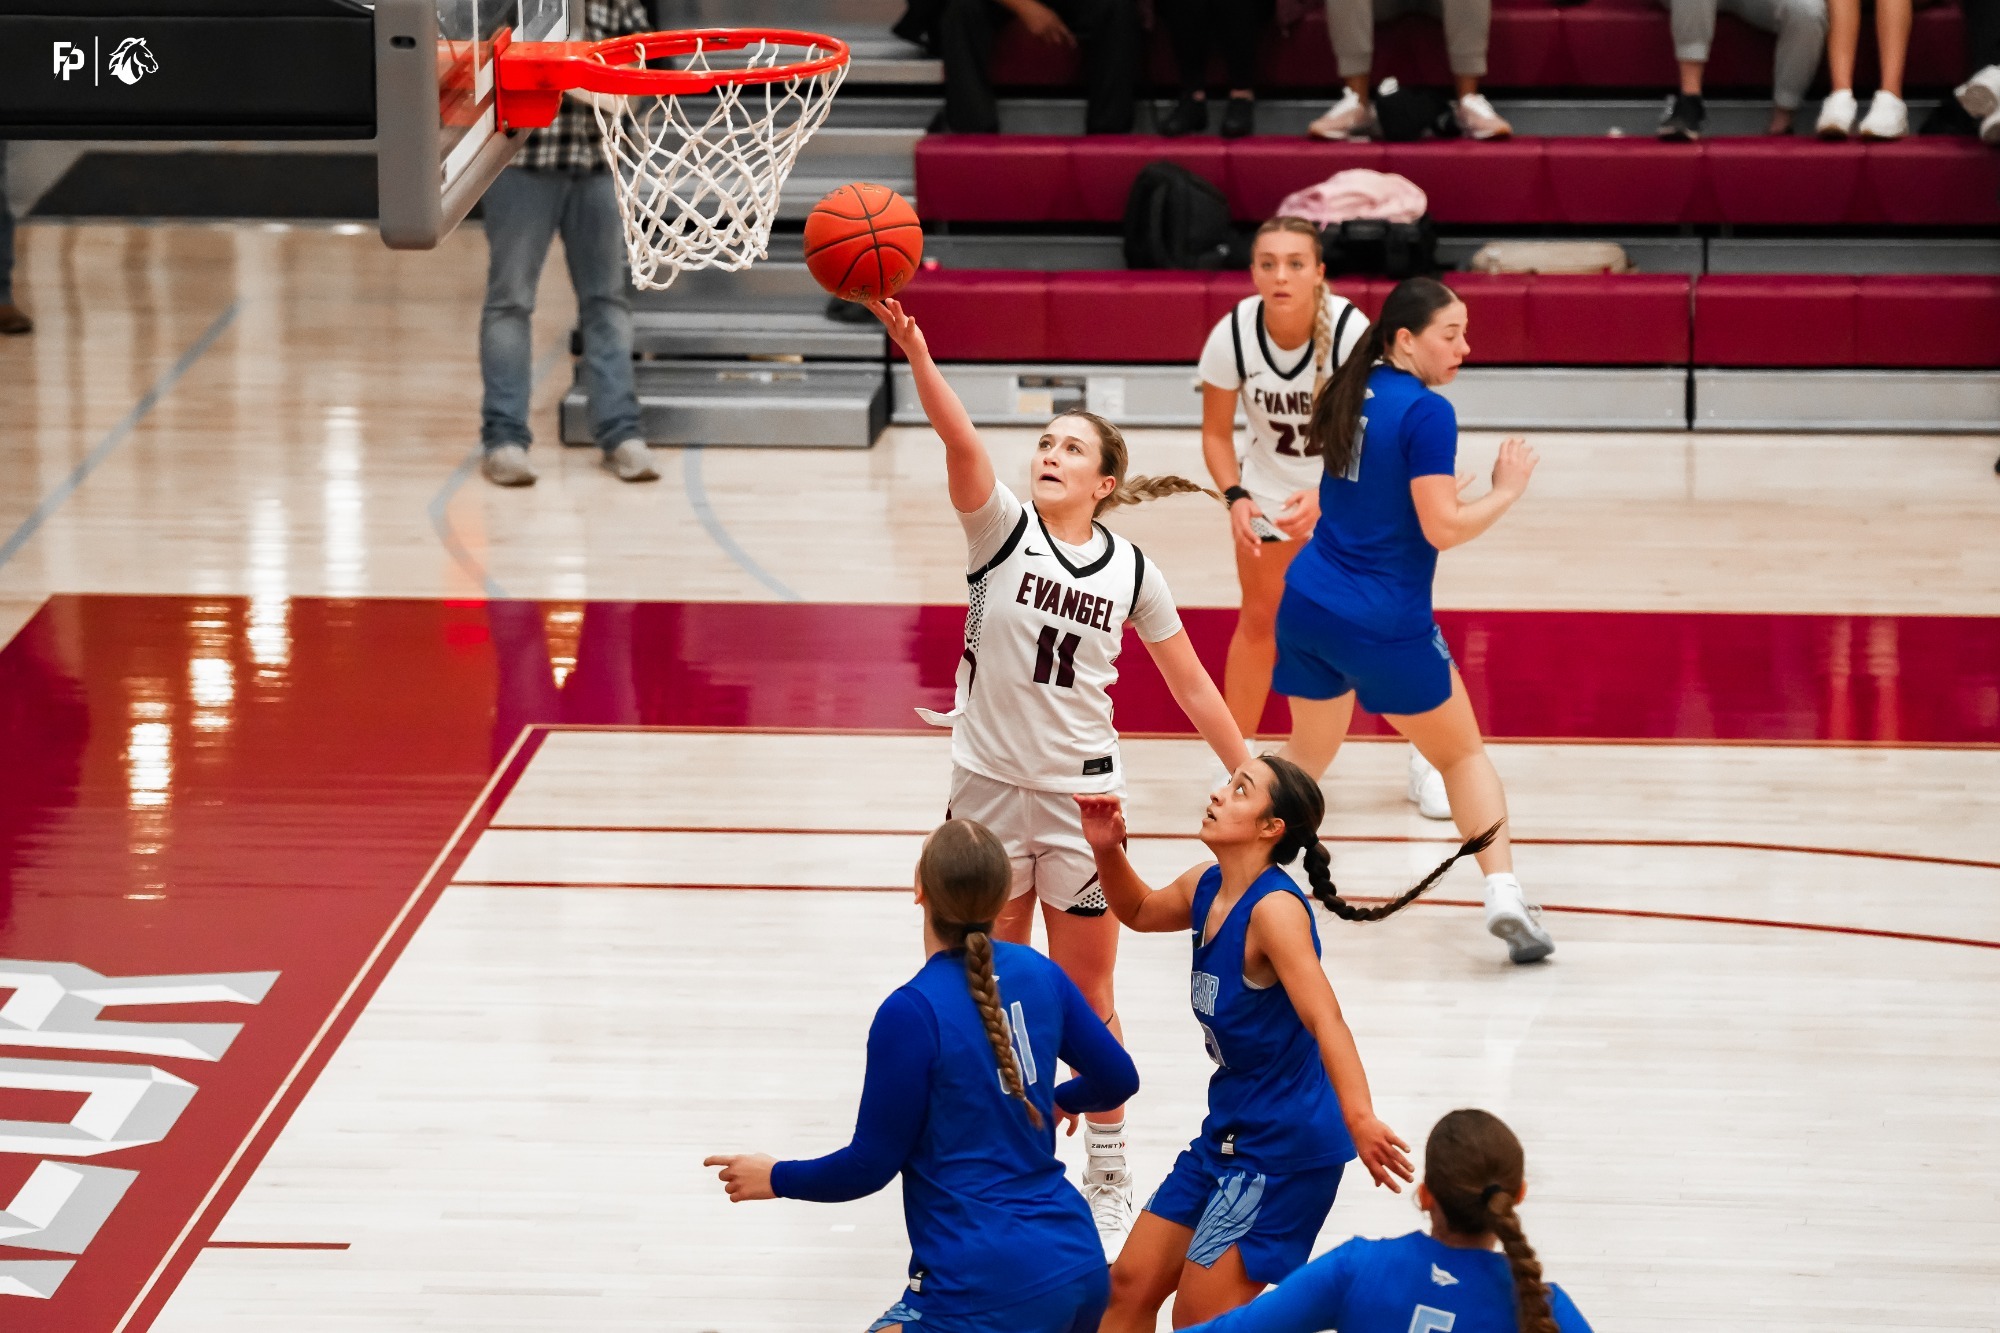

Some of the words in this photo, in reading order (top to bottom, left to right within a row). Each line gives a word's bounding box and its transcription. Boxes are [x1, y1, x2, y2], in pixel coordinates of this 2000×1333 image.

[1254, 388, 1313, 416] EVANG
[1016, 571, 1115, 633] EVANGEL
[1033, 624, 1082, 689] 11
